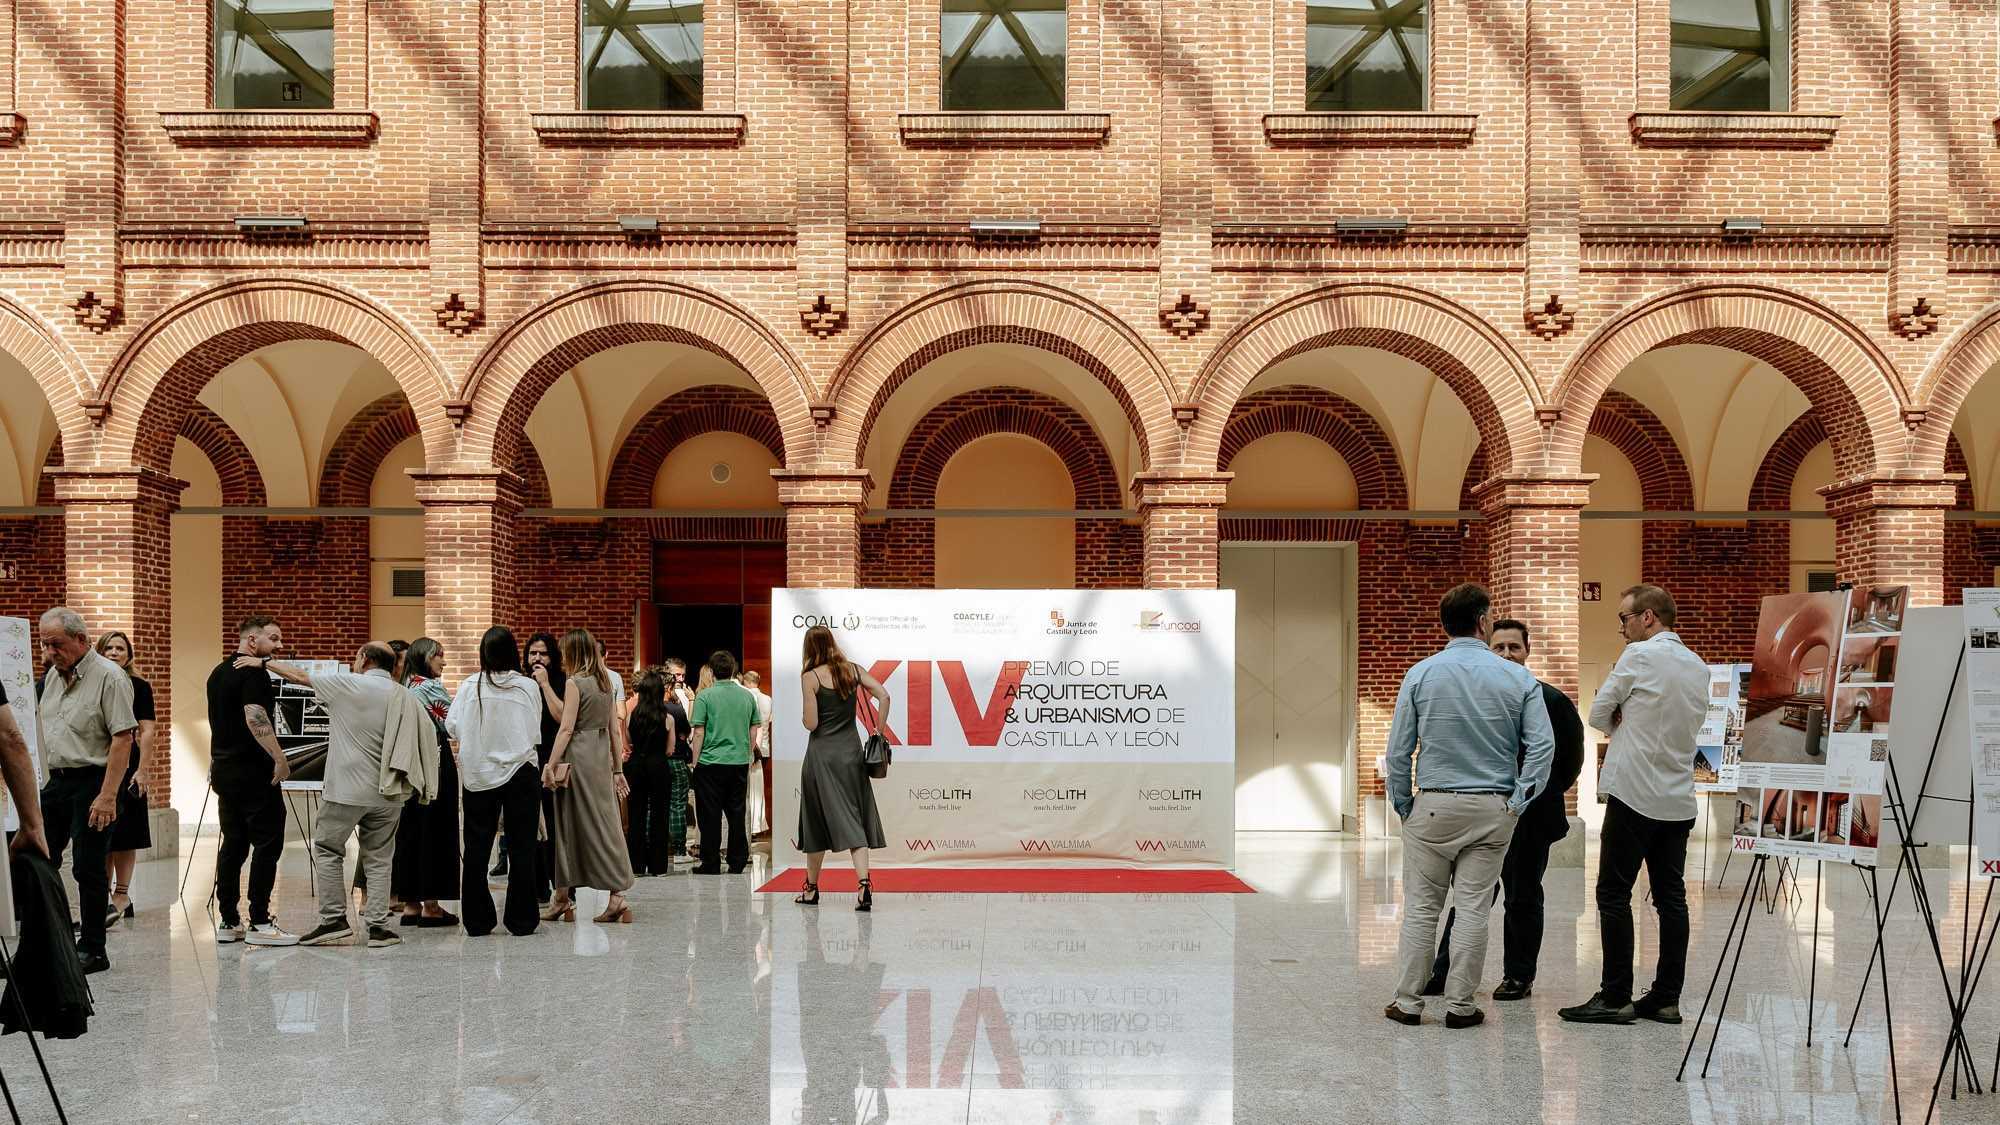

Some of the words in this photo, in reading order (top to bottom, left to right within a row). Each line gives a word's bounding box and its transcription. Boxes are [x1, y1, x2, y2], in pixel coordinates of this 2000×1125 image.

[792, 615, 839, 629] COAL
[1066, 620, 1087, 628] Junta
[1088, 620, 1098, 628] de
[1073, 629, 1078, 637] y
[1079, 627, 1098, 635] León
[1004, 660, 1085, 676] PREMIO
[1091, 660, 1120, 676] DE
[1004, 684, 1168, 704] ARQUITECTURA
[1004, 707, 1020, 724] &
[1025, 707, 1151, 723] URBANISMO
[1157, 708, 1185, 723] DE
[1004, 731, 1099, 747] CASTILLA
[1105, 731, 1118, 746] Y
[1124, 728, 1179, 747] LEÓN
[936, 839, 976, 849] VALMMA
[1051, 839, 1091, 849] VALMMA
[1166, 839, 1206, 849] VALMMA
[1735, 837, 1755, 850] XIV
